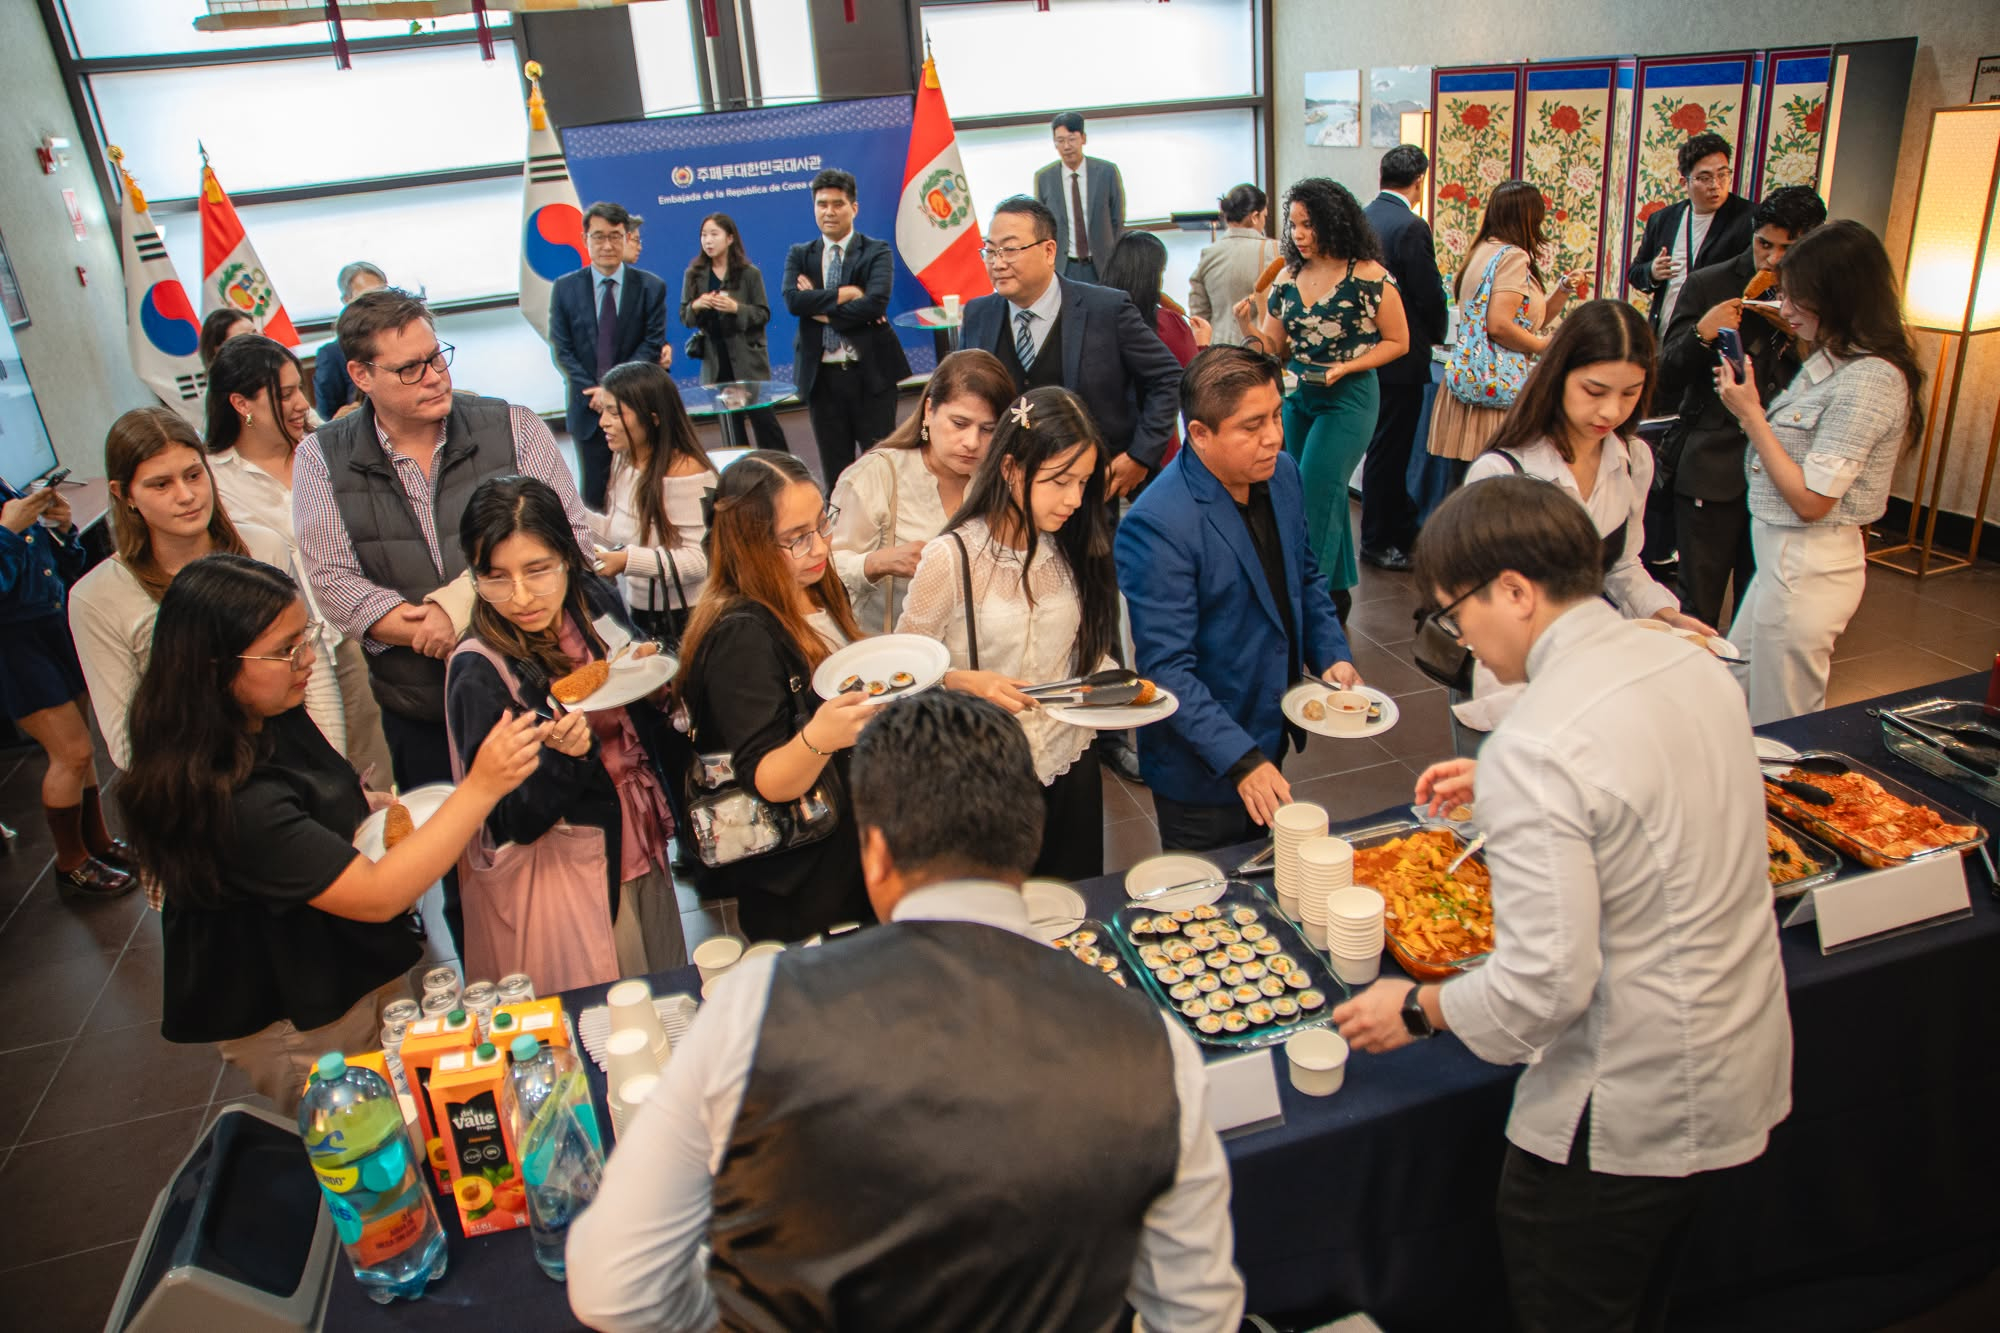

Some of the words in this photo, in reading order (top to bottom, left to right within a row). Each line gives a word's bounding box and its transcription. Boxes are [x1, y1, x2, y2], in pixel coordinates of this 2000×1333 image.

[697, 155, 821, 182] 주페루대한민국대사관
[658, 193, 701, 206] Embajada
[702, 190, 714, 200] de
[715, 189, 724, 198] la
[769, 183, 780, 193] de
[781, 181, 807, 191] Corea
[452, 1113, 496, 1130] Valle
